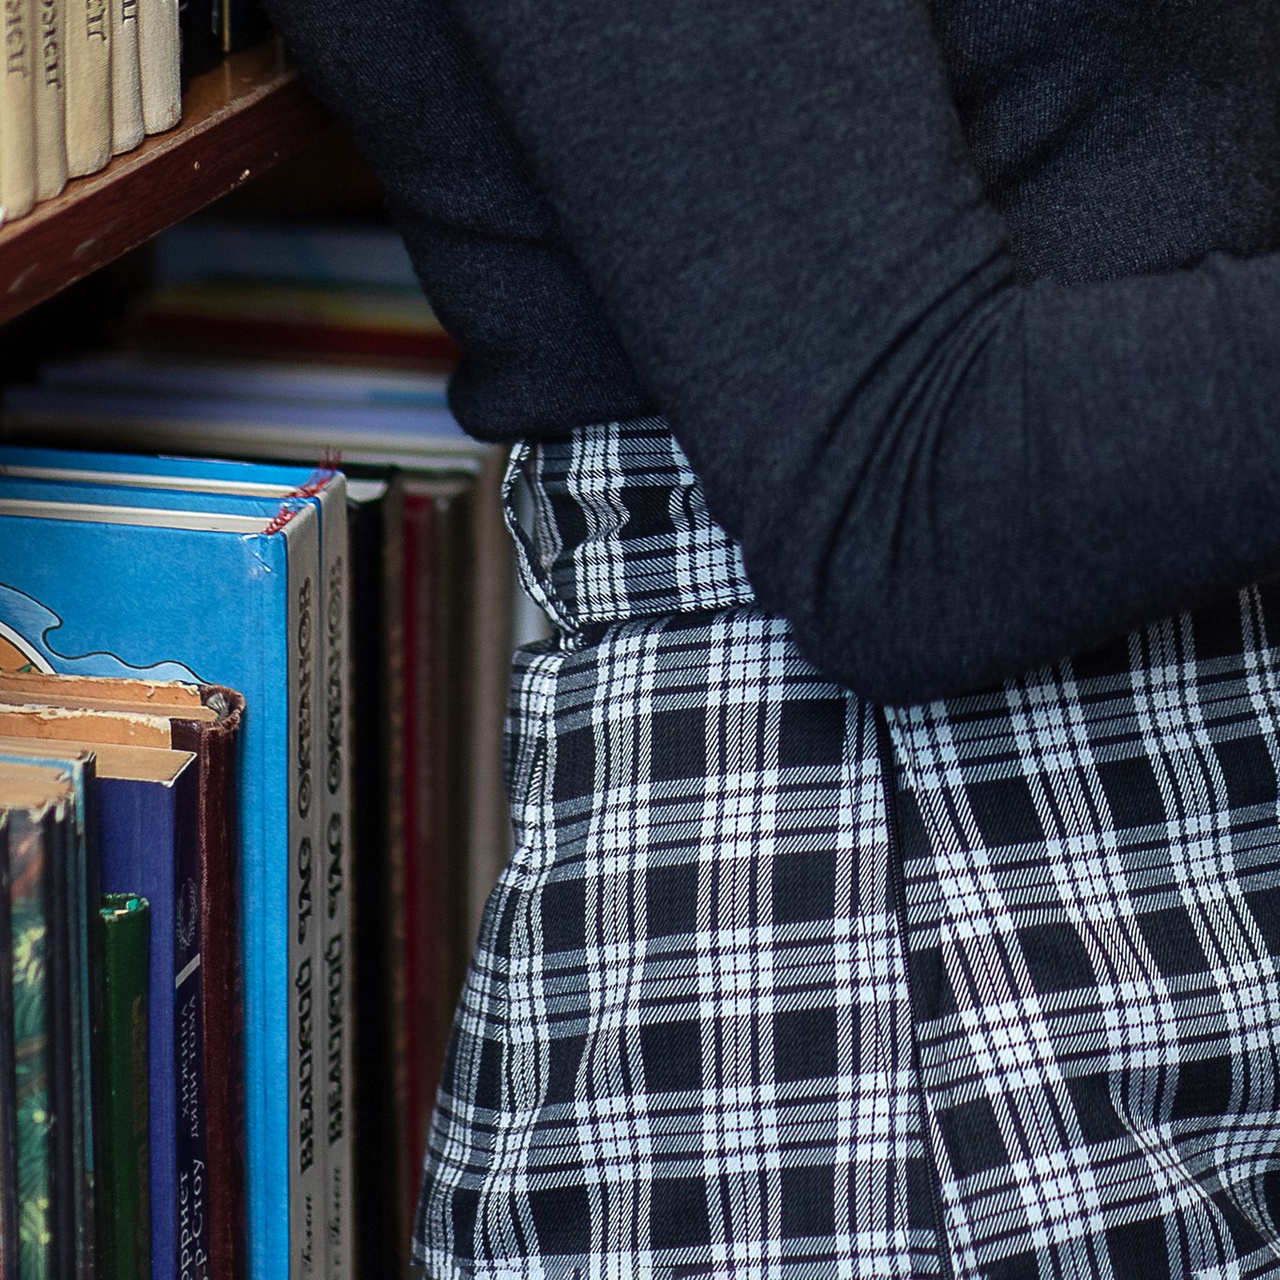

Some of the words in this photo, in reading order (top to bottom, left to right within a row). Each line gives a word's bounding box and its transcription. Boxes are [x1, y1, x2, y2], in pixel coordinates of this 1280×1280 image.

[297, 577, 312, 820] ОКЕАНОВ
[326, 555, 342, 795] ОКЕАНОВ
[297, 837, 312, 945] ЧАС
[327, 812, 342, 920] ЧАС
[181, 1003, 190, 1117] ХИЖИНА
[189, 994, 197, 1063] ТОМА
[294, 956, 313, 1175] ВЕЛИКИЙ
[324, 932, 343, 1147] ВЕЛИКИЙ
[190, 1072, 199, 1138] ДЯДИ
